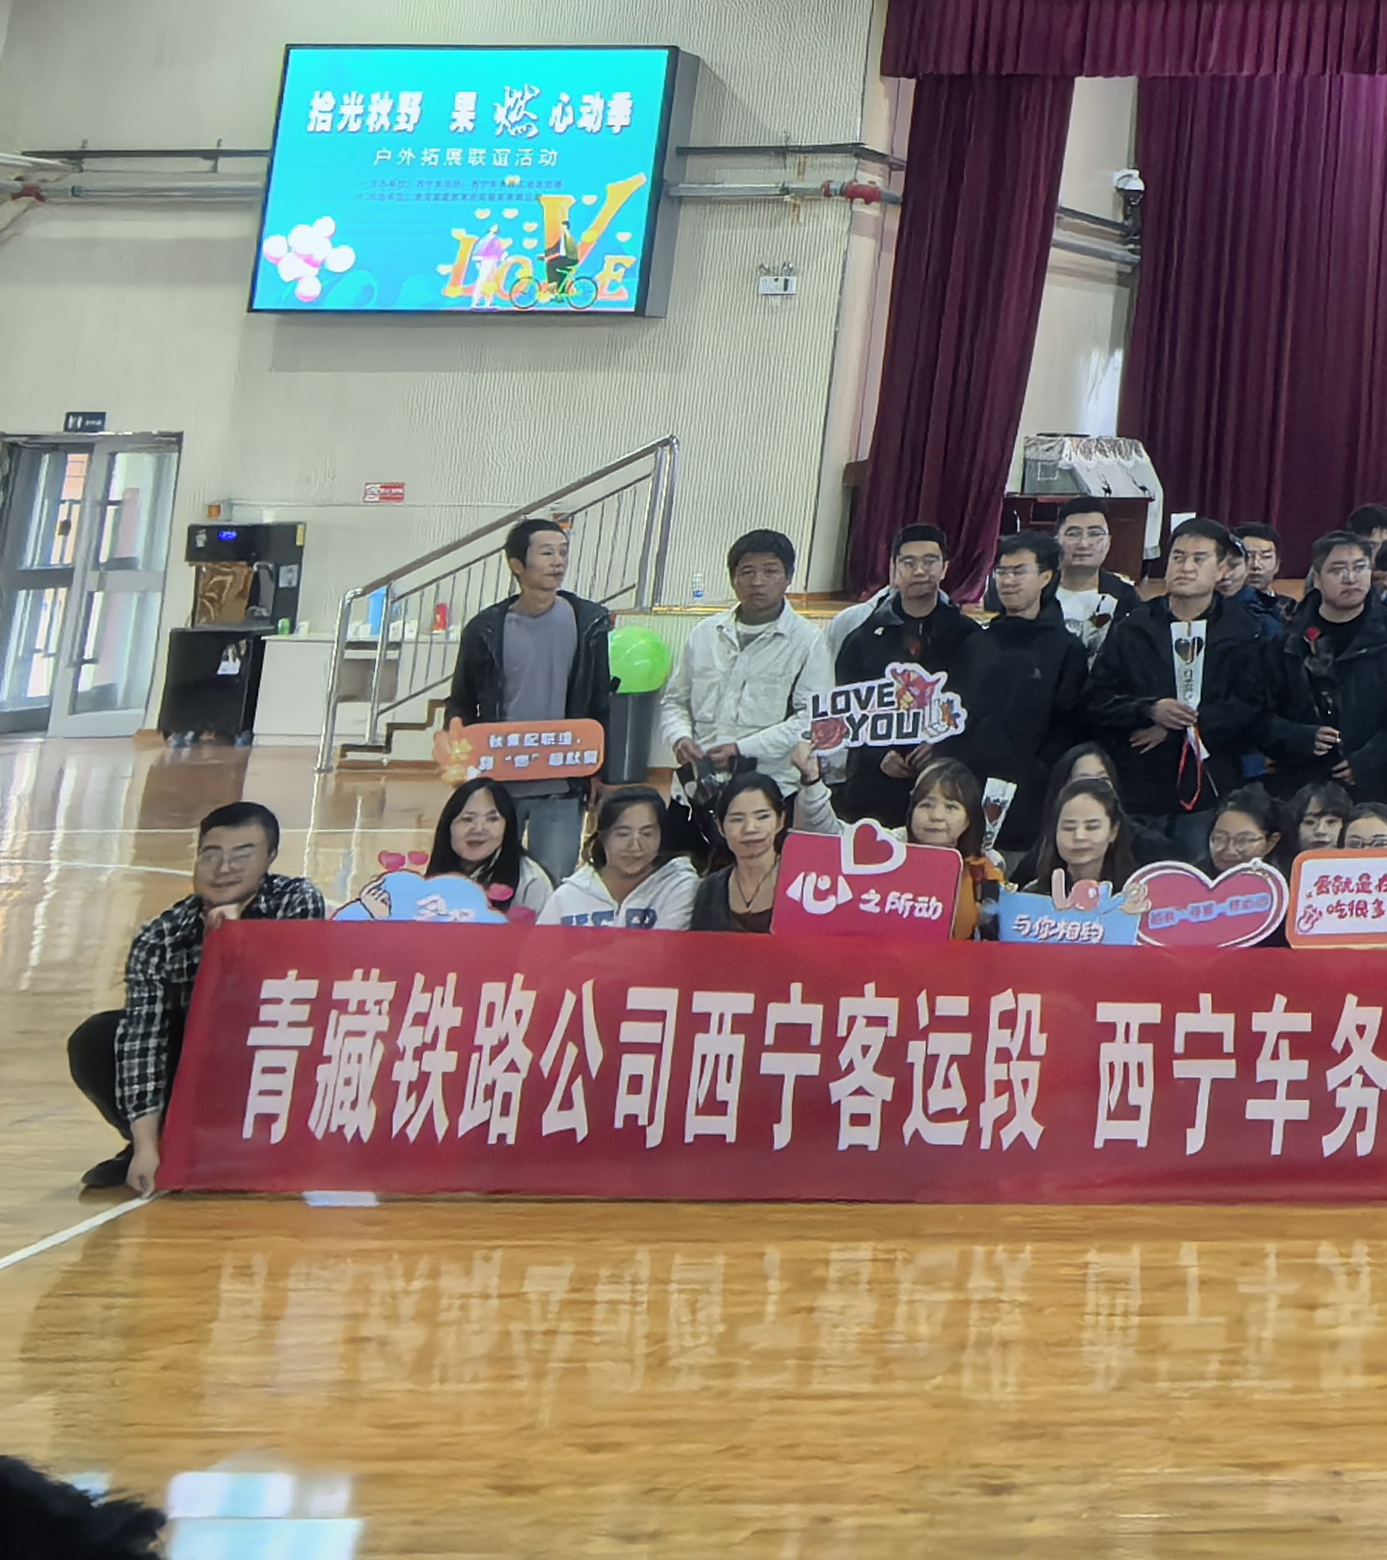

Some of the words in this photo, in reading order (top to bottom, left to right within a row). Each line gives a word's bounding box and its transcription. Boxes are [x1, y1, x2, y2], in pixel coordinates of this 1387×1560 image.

[307, 90, 424, 135] 拾光秋野
[373, 147, 560, 169] 户外拓展联谊活动
[811, 680, 897, 719] LOVE
[845, 711, 922, 742] YOU
[785, 871, 943, 921] 心之所动
[1011, 913, 1105, 945] 与你相约
[241, 967, 1049, 1153] 青藏铁路公司西宁客运段
